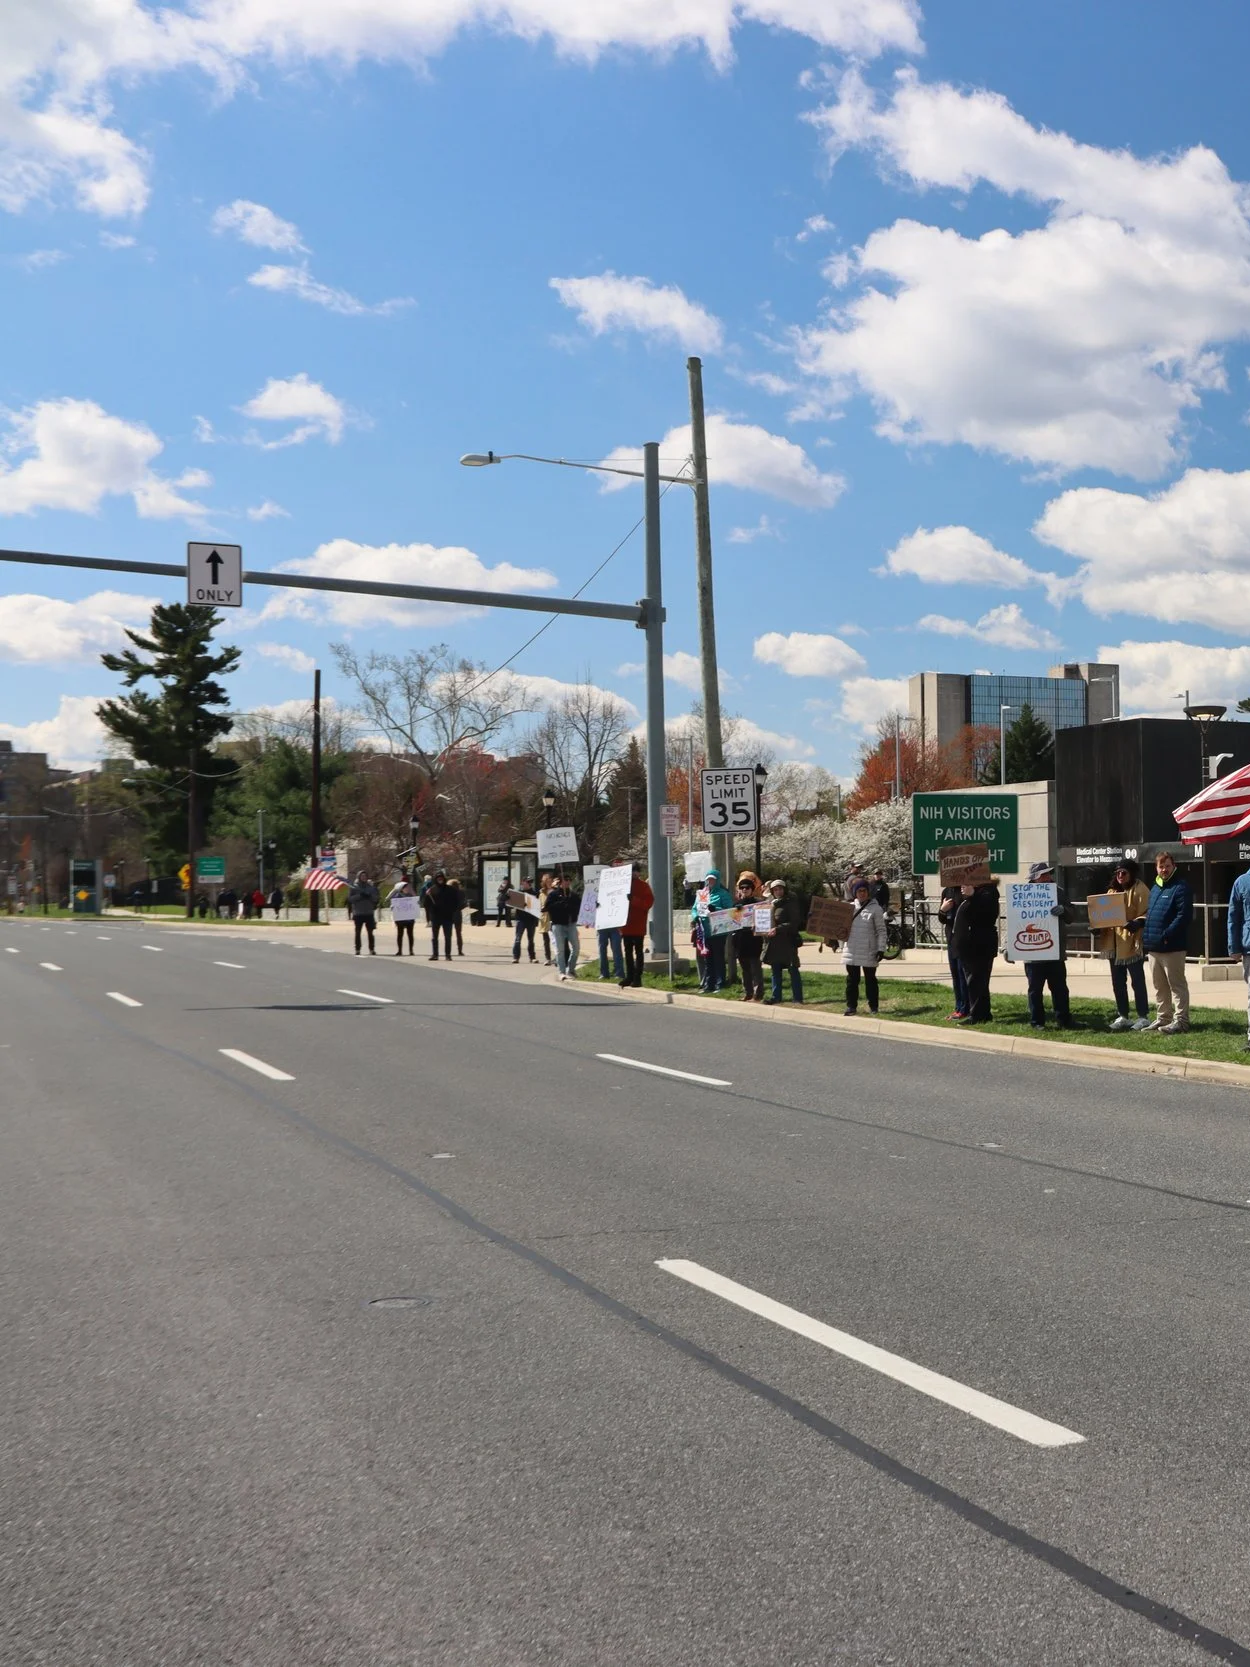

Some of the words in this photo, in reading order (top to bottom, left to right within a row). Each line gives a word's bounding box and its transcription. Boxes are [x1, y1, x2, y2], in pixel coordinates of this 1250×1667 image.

[196, 589, 234, 602] ONLY
[705, 774, 750, 786] SPEED
[711, 787, 745, 799] LIMIT
[709, 801, 751, 827] 35
[920, 806, 943, 819] NIH
[947, 806, 1011, 819] VISITORS
[935, 828, 996, 841] PARKING
[925, 849, 940, 862] NE
[1092, 847, 1106, 855] Center
[1194, 844, 1203, 857] M
[943, 856, 970, 869] HANDS
[1100, 855, 1122, 863] Mezzanine
[1012, 884, 1033, 893] STOP
[1036, 883, 1050, 891] THE
[1012, 892, 1051, 900] CRIMINAL
[1012, 900, 1054, 908] PRESIDENT
[1021, 910, 1048, 919] DUMP
[1022, 933, 1049, 942] TRUMP
